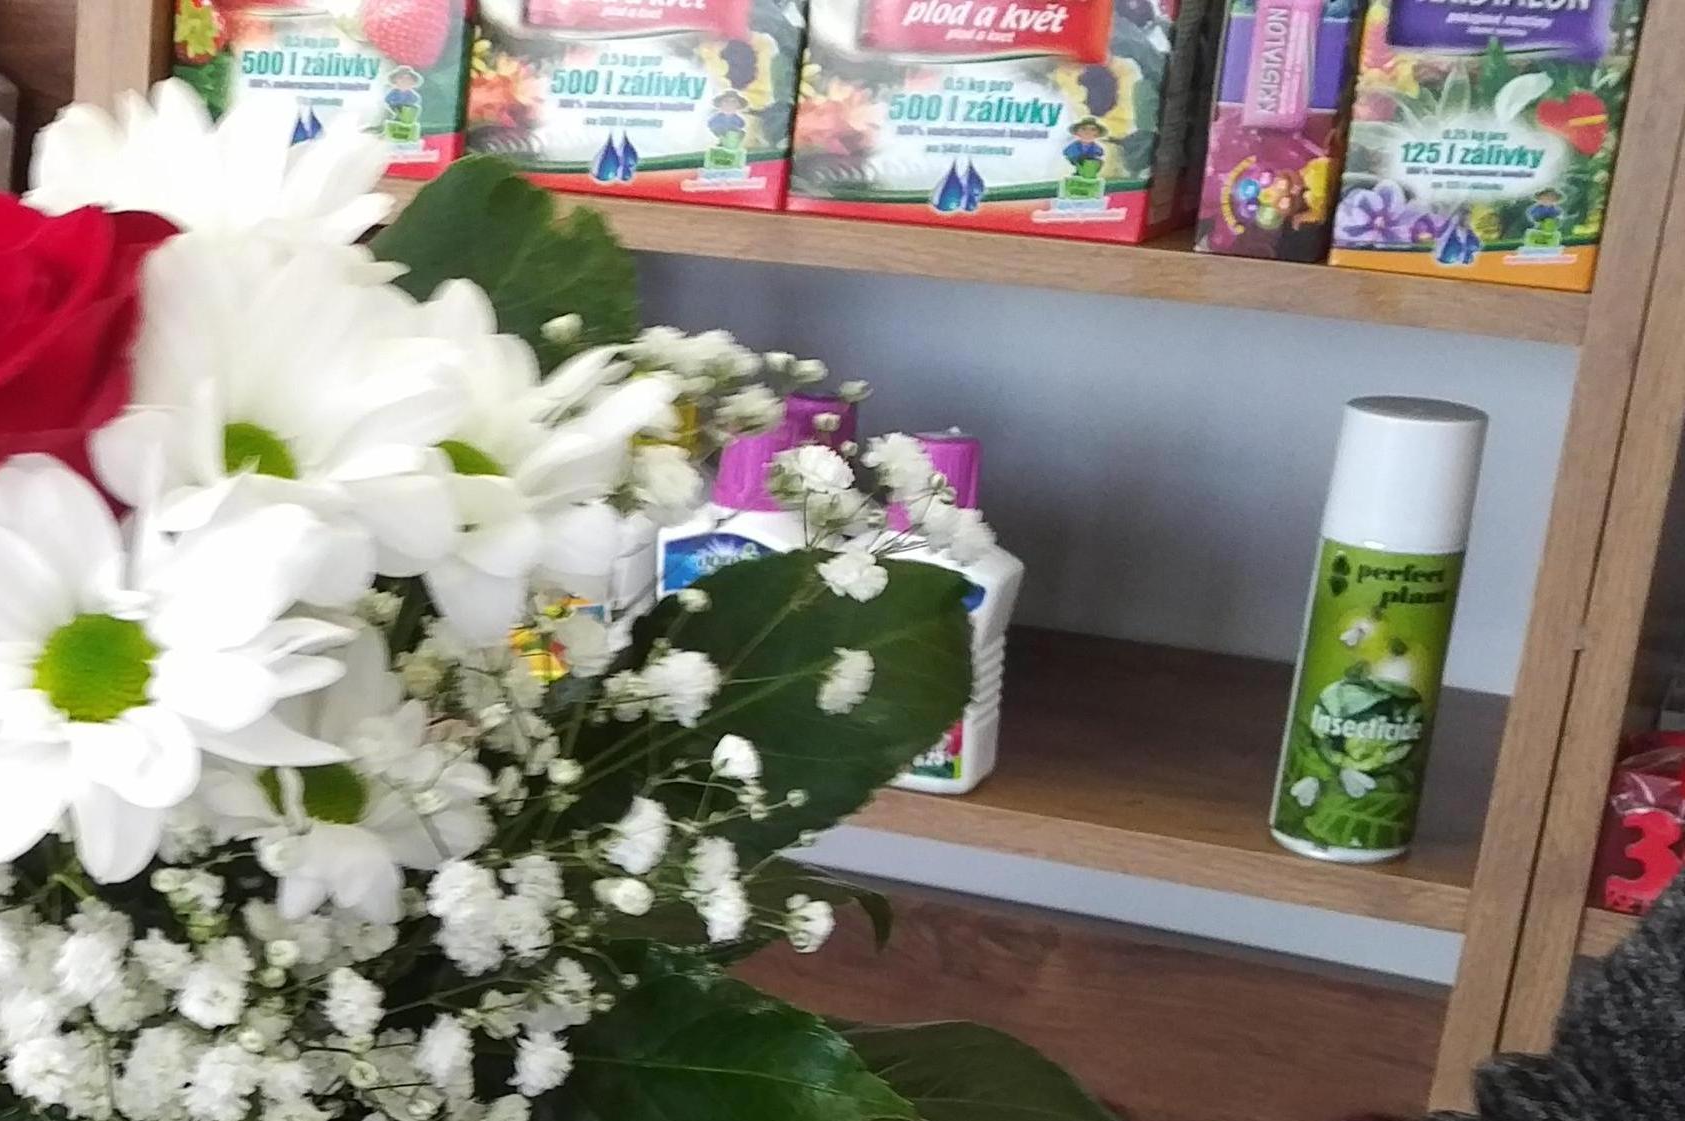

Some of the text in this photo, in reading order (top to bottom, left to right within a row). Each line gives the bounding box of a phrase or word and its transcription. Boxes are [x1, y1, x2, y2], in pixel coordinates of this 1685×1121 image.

[902, 0, 1069, 33] plod a květ
[242, 51, 283, 75] 500
[302, 49, 380, 80] zálivky
[550, 69, 599, 95] 500
[617, 69, 707, 100] zálivky
[888, 93, 942, 121] 500
[963, 93, 1064, 128] zálivky
[1401, 142, 1440, 164] 125
[1459, 141, 1545, 169] zálivky
